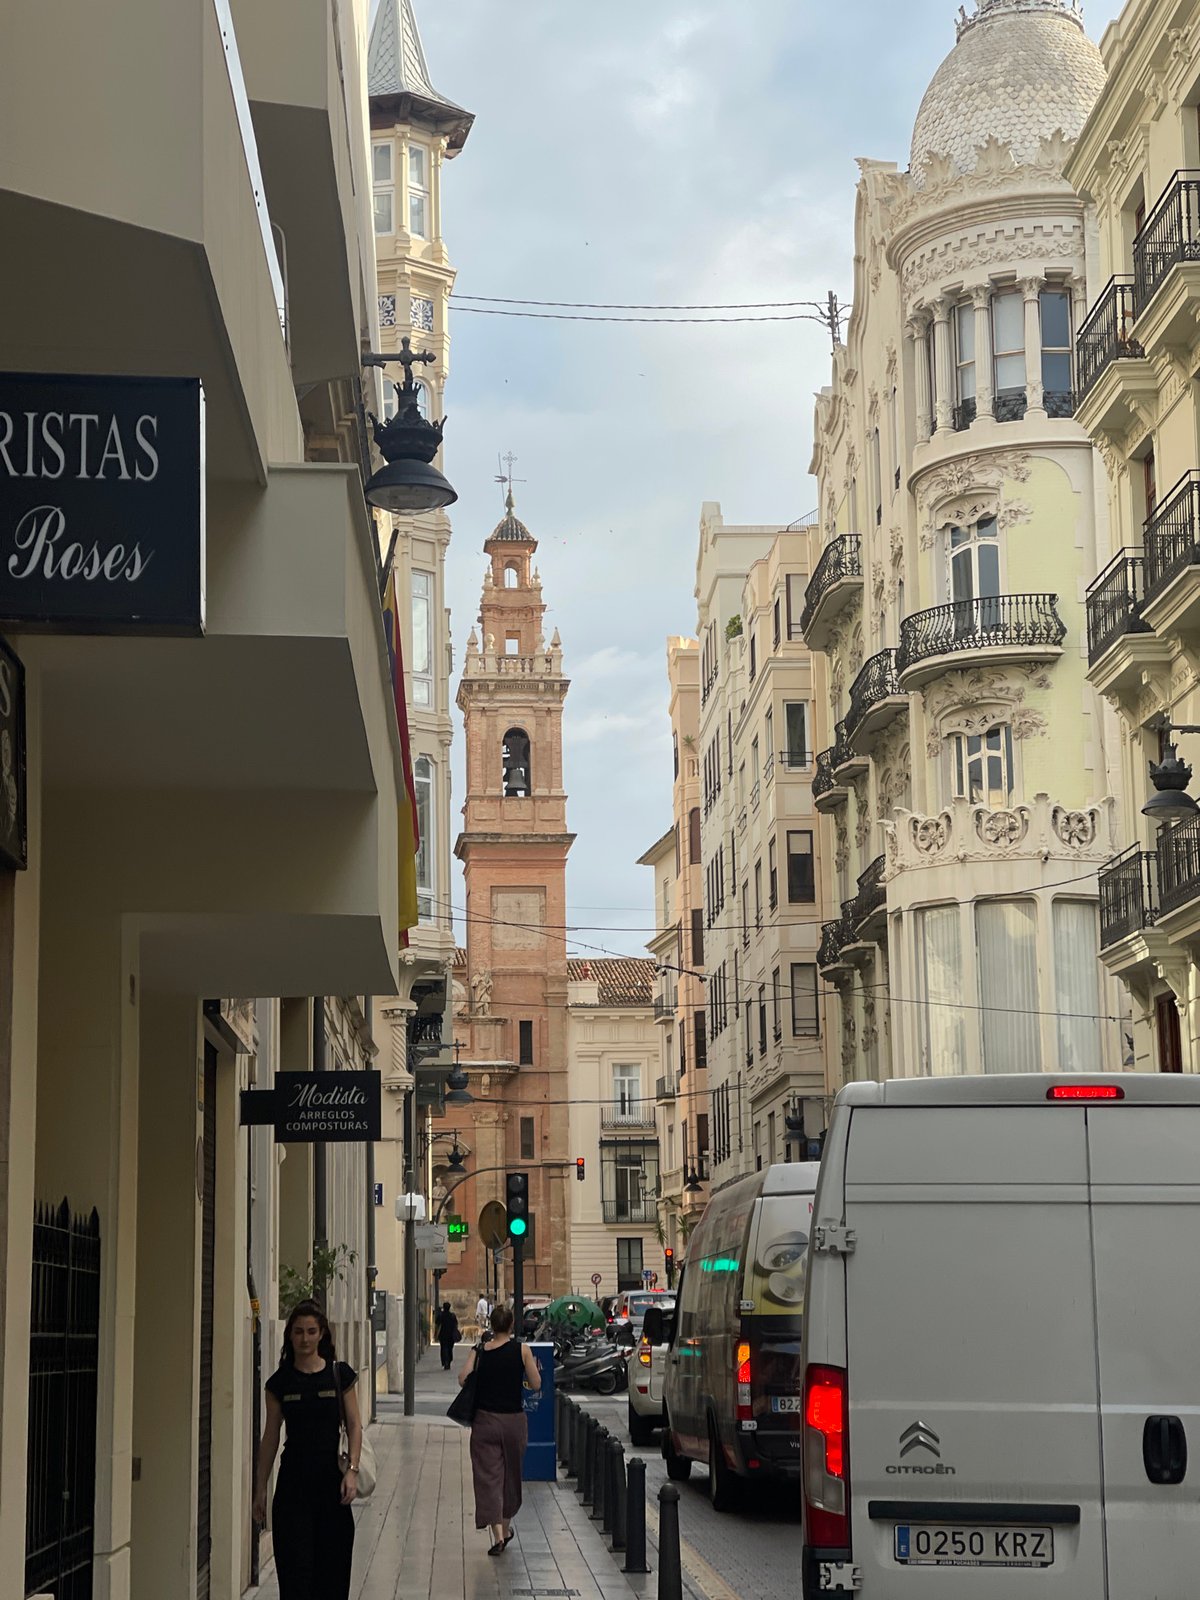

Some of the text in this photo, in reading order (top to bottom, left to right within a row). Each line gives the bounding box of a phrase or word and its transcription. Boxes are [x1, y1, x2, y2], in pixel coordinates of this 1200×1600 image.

[0, 411, 159, 481] RISTAS
[8, 504, 154, 581] Roses
[287, 1083, 368, 1108] Modista
[286, 1121, 369, 1131] COMPOSTURAS
[299, 1110, 355, 1120] ARREGLOS
[915, 1530, 984, 1556] 0250
[995, 1532, 1046, 1557] KRZ
